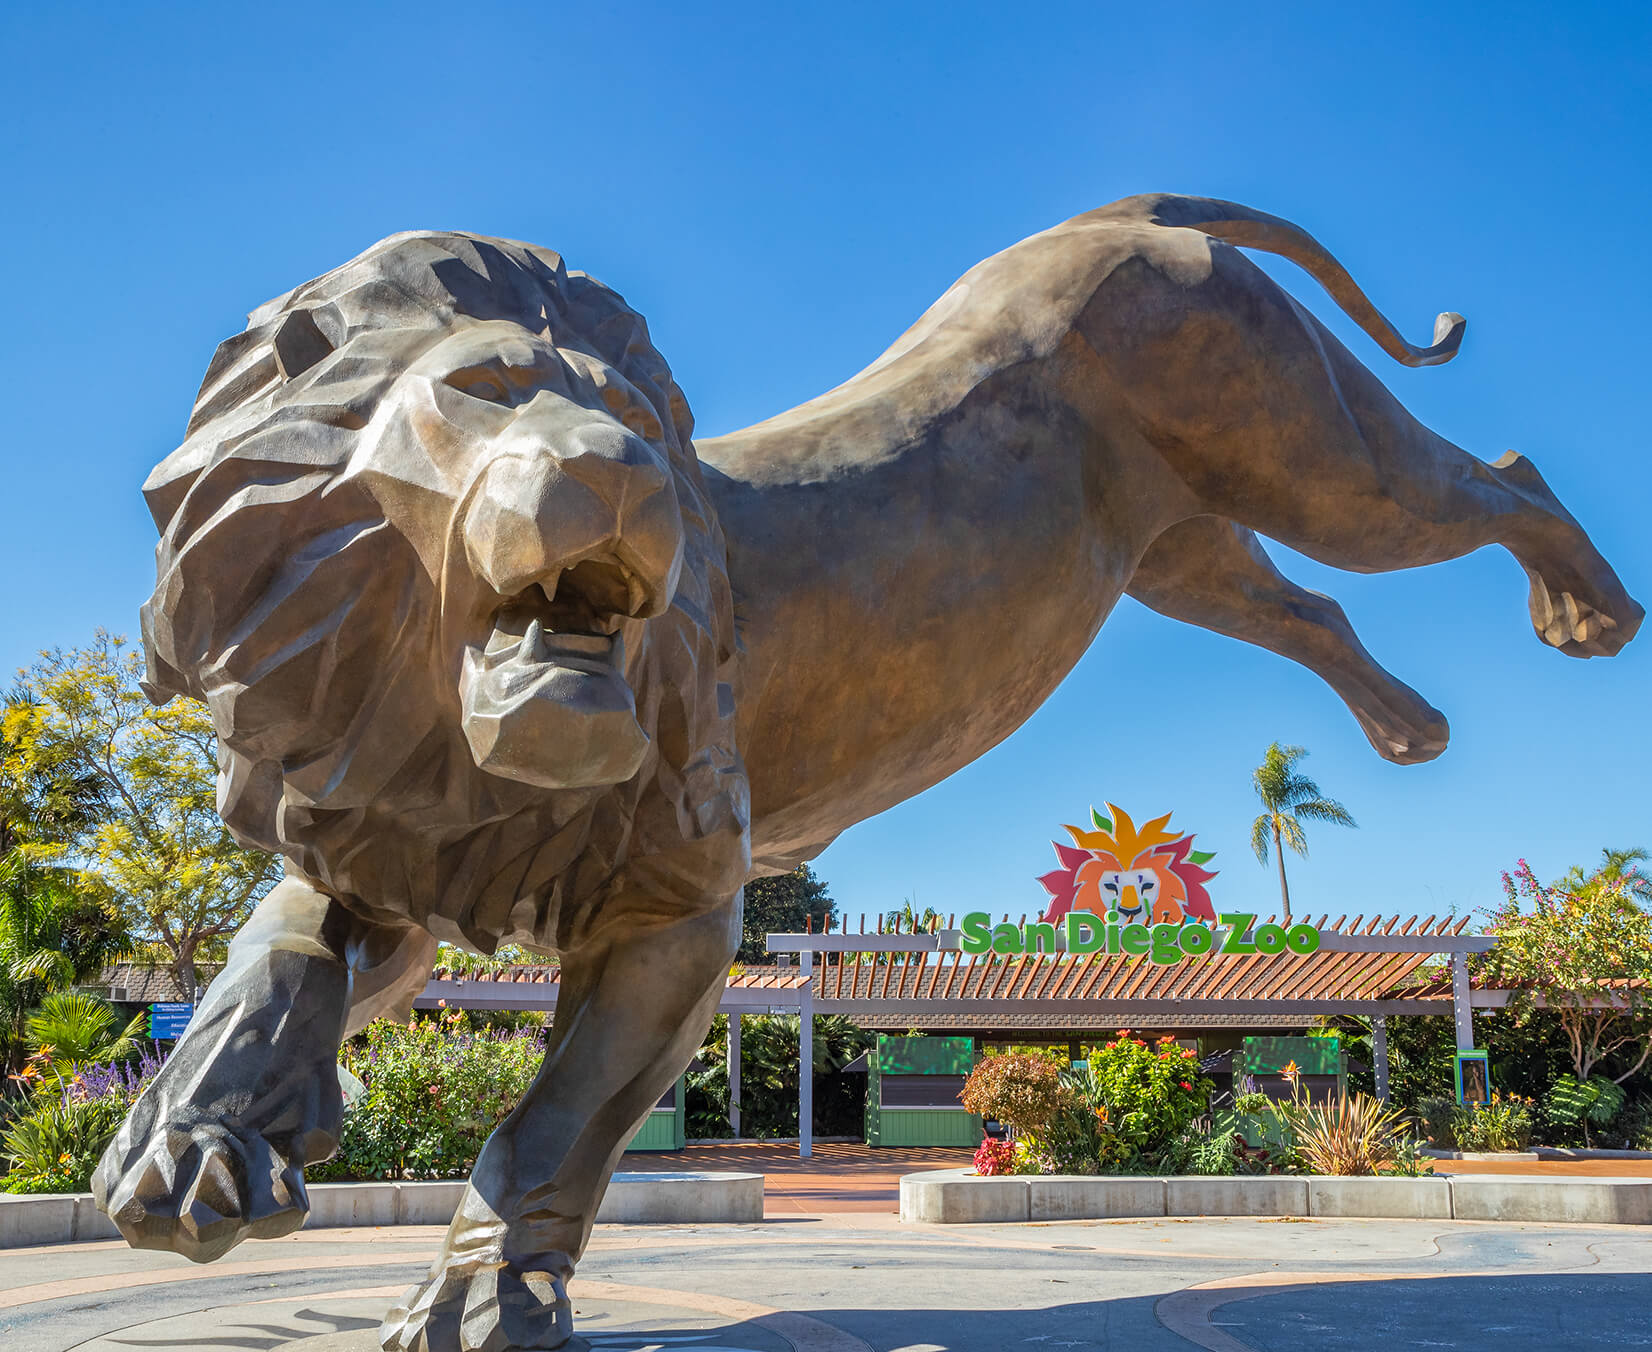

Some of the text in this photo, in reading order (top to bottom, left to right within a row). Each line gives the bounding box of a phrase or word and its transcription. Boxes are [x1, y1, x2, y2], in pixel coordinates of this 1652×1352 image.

[961, 910, 1321, 966] San Diego Zoo
